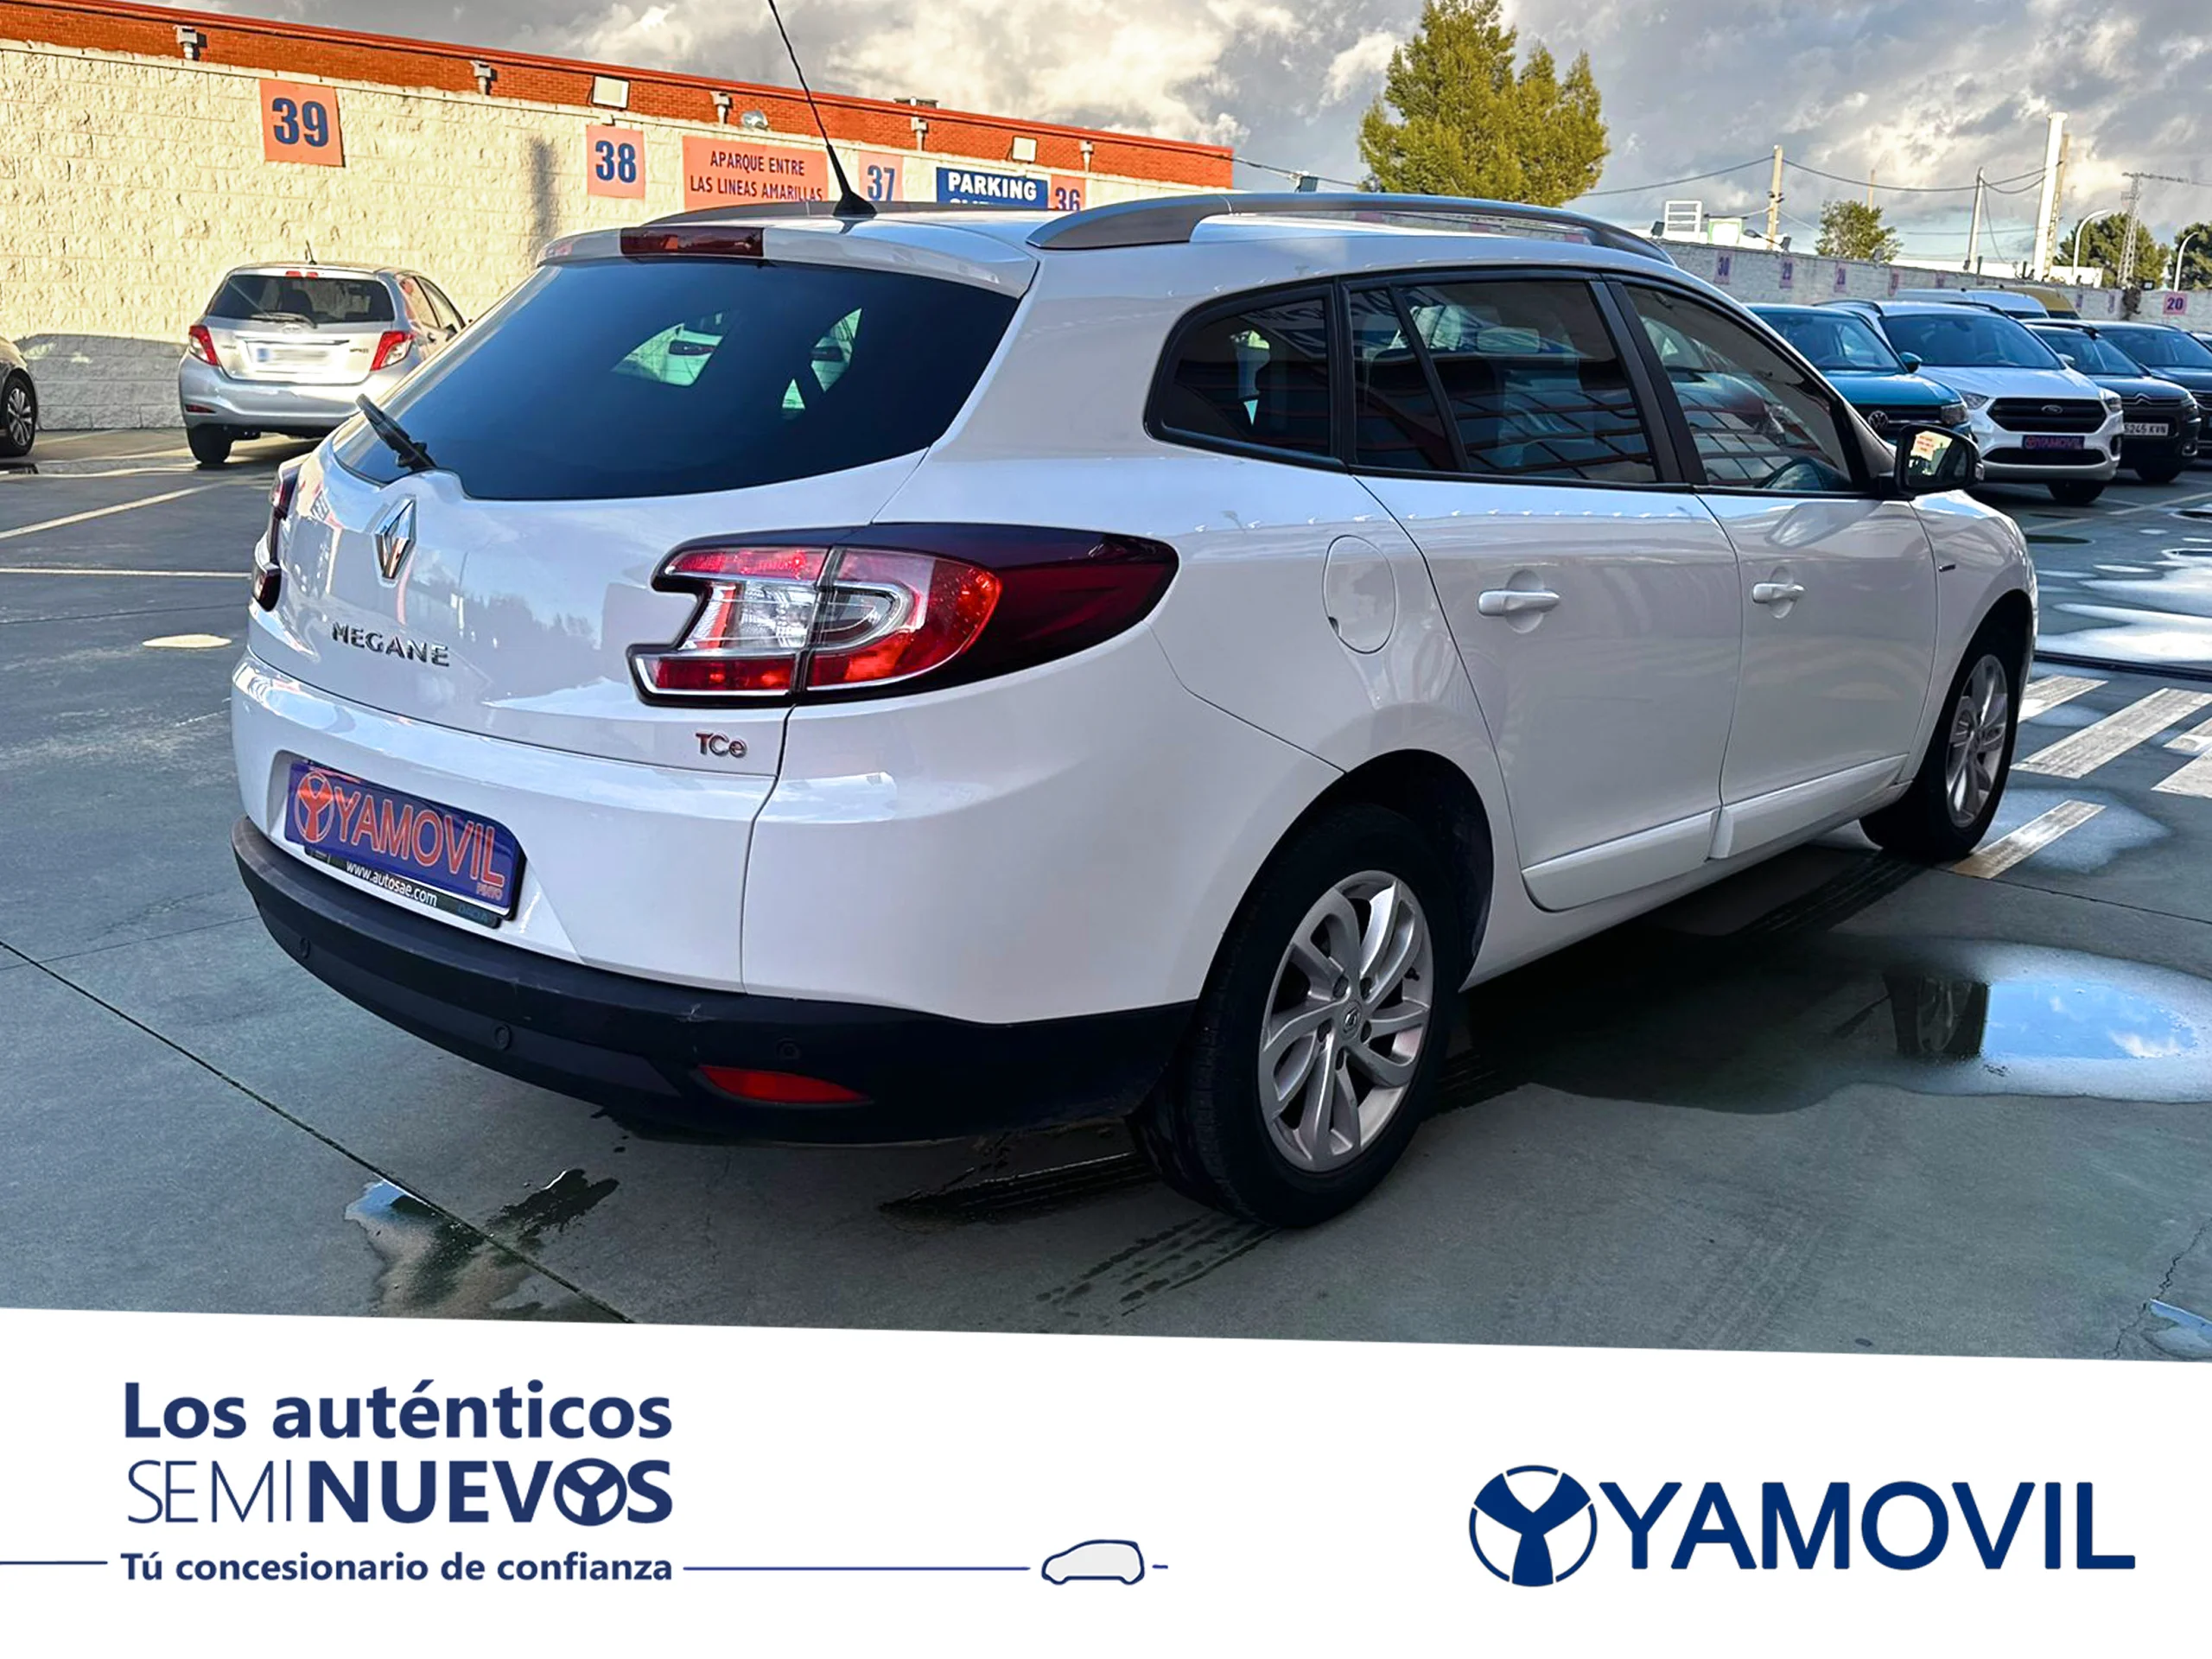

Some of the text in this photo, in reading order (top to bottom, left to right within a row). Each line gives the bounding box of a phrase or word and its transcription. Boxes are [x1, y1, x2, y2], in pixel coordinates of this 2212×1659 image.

[271, 97, 329, 149] 39
[594, 139, 637, 183] 38
[709, 149, 805, 176] APARQUE ENTRE
[690, 175, 823, 202] LAS LINEAS AMARILLAS
[867, 164, 895, 201] 37
[947, 171, 1037, 201] PARKING
[1054, 187, 1081, 211] 36
[2166, 296, 2184, 311] 20
[332, 621, 450, 668] MEGANE
[695, 732, 748, 759] TCe
[334, 786, 505, 888] YAMOVIL
[346, 861, 438, 907] www.autosae.com
